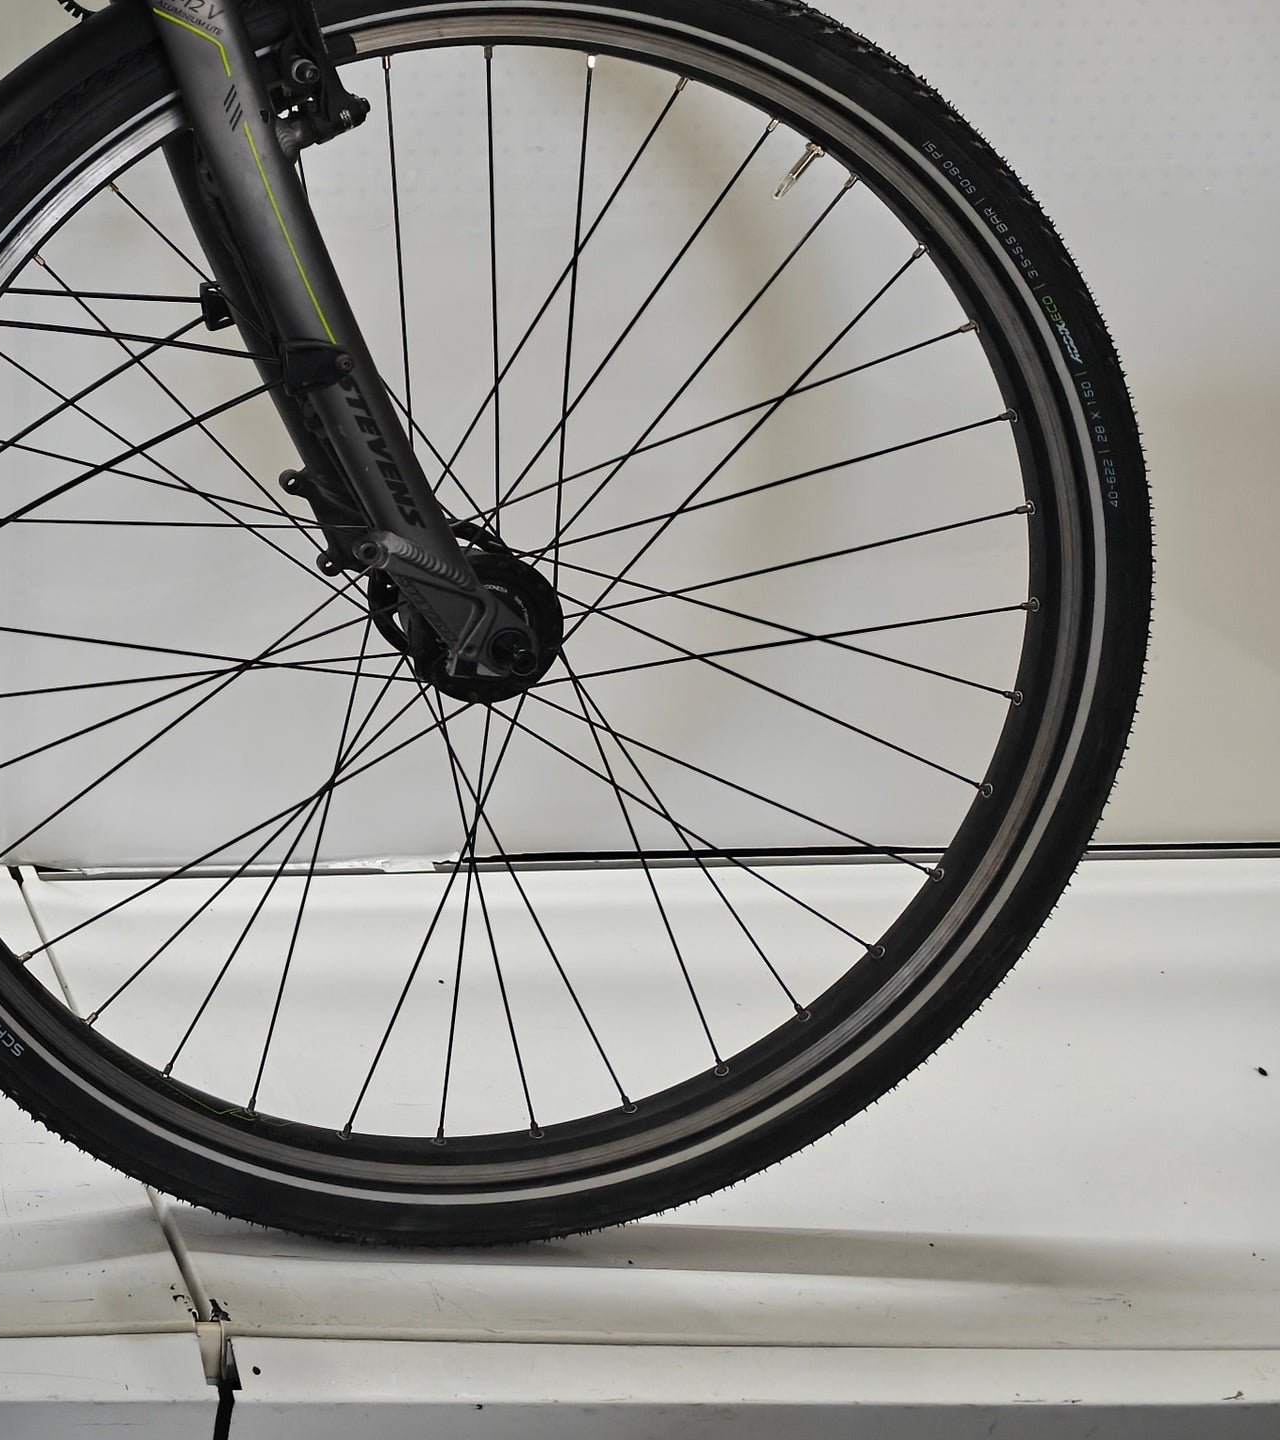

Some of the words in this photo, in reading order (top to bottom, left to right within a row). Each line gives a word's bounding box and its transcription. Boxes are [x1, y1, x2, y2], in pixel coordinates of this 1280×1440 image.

[156, 0, 207, 30] ALUMINIUM
[205, 23, 223, 36] LITE
[207, 4, 225, 20] V
[922, 140, 944, 160] PSI
[942, 160, 977, 194] 50-80
[983, 206, 1009, 234] BAR
[1005, 235, 1039, 279] 3.5-5.5
[1091, 410, 1102, 421] X
[1095, 424, 1108, 443] 28
[339, 374, 427, 528] STEVENS
[1103, 458, 1119, 508] 40-622
